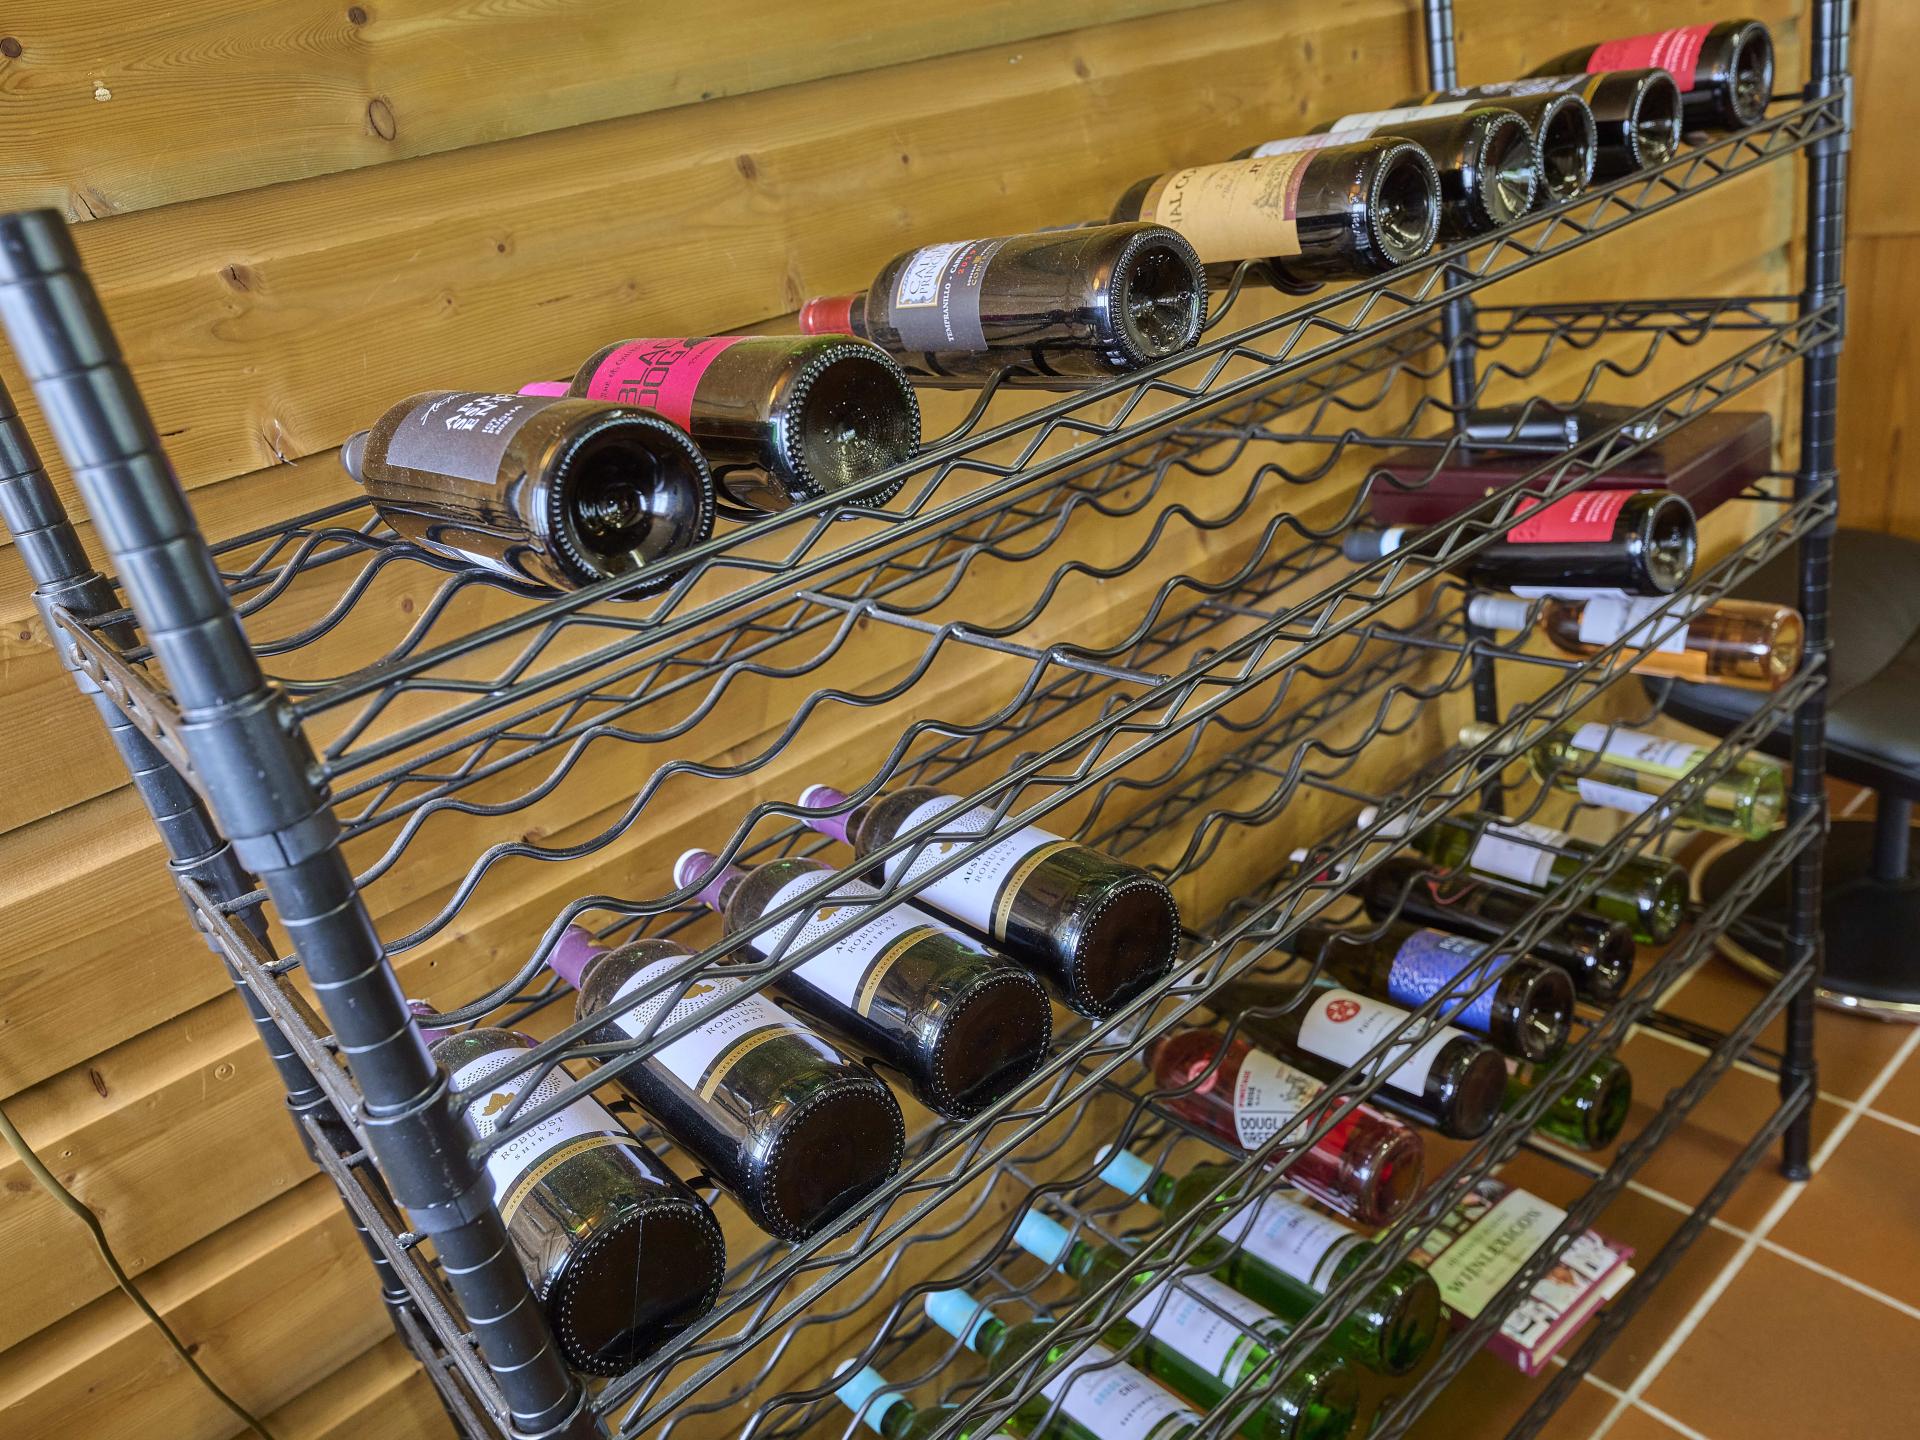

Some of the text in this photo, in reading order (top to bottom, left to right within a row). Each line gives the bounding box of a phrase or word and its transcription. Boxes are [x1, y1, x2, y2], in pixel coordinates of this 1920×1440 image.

[942, 282, 955, 343] TEMPRANILLO
[617, 340, 685, 404] BLAC
[638, 350, 685, 409] DOG
[973, 839, 1015, 883] ROBUUST
[987, 846, 1017, 880] SHIRAZ
[847, 914, 896, 954] ROBUUST
[861, 922, 898, 952] SHIRAZ
[705, 1007, 764, 1036] ROBUUST
[721, 1014, 767, 1035] SHIRAZ
[500, 1115, 564, 1161] ROBUUST
[514, 1126, 564, 1161] SHIRAZ
